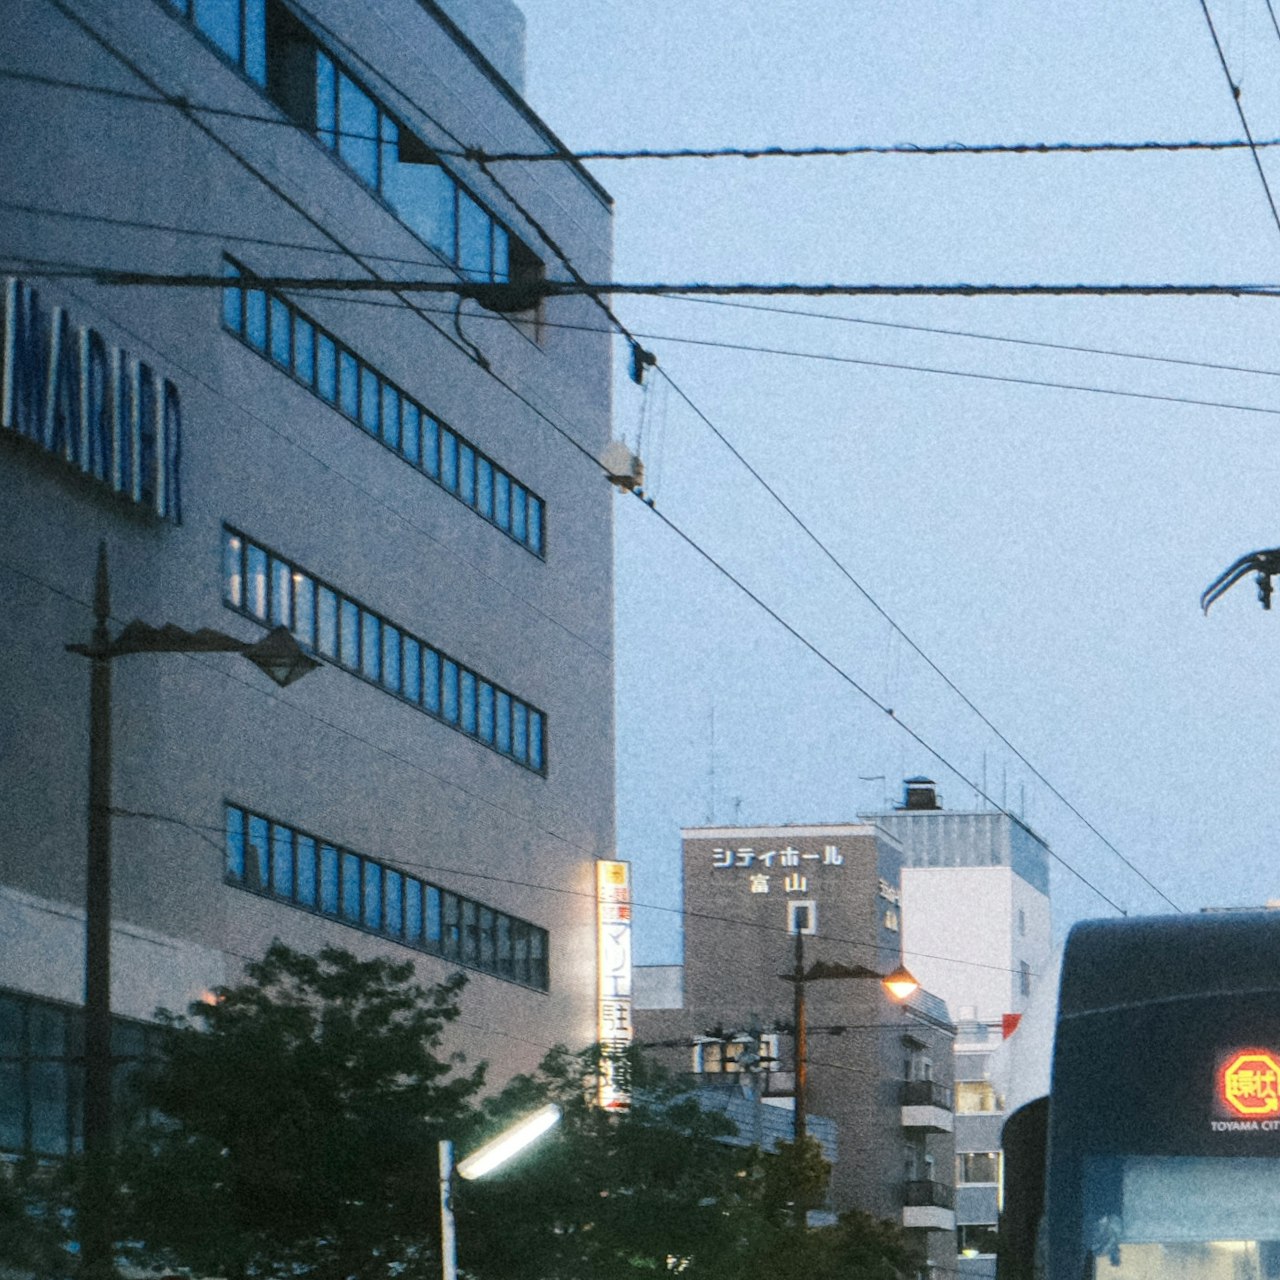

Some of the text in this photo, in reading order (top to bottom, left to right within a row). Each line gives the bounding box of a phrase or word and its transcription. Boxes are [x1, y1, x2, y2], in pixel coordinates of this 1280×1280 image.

[712, 846, 844, 868] シティホール
[750, 873, 807, 894] 富山
[1211, 1121, 1259, 1131] TOYAMA
